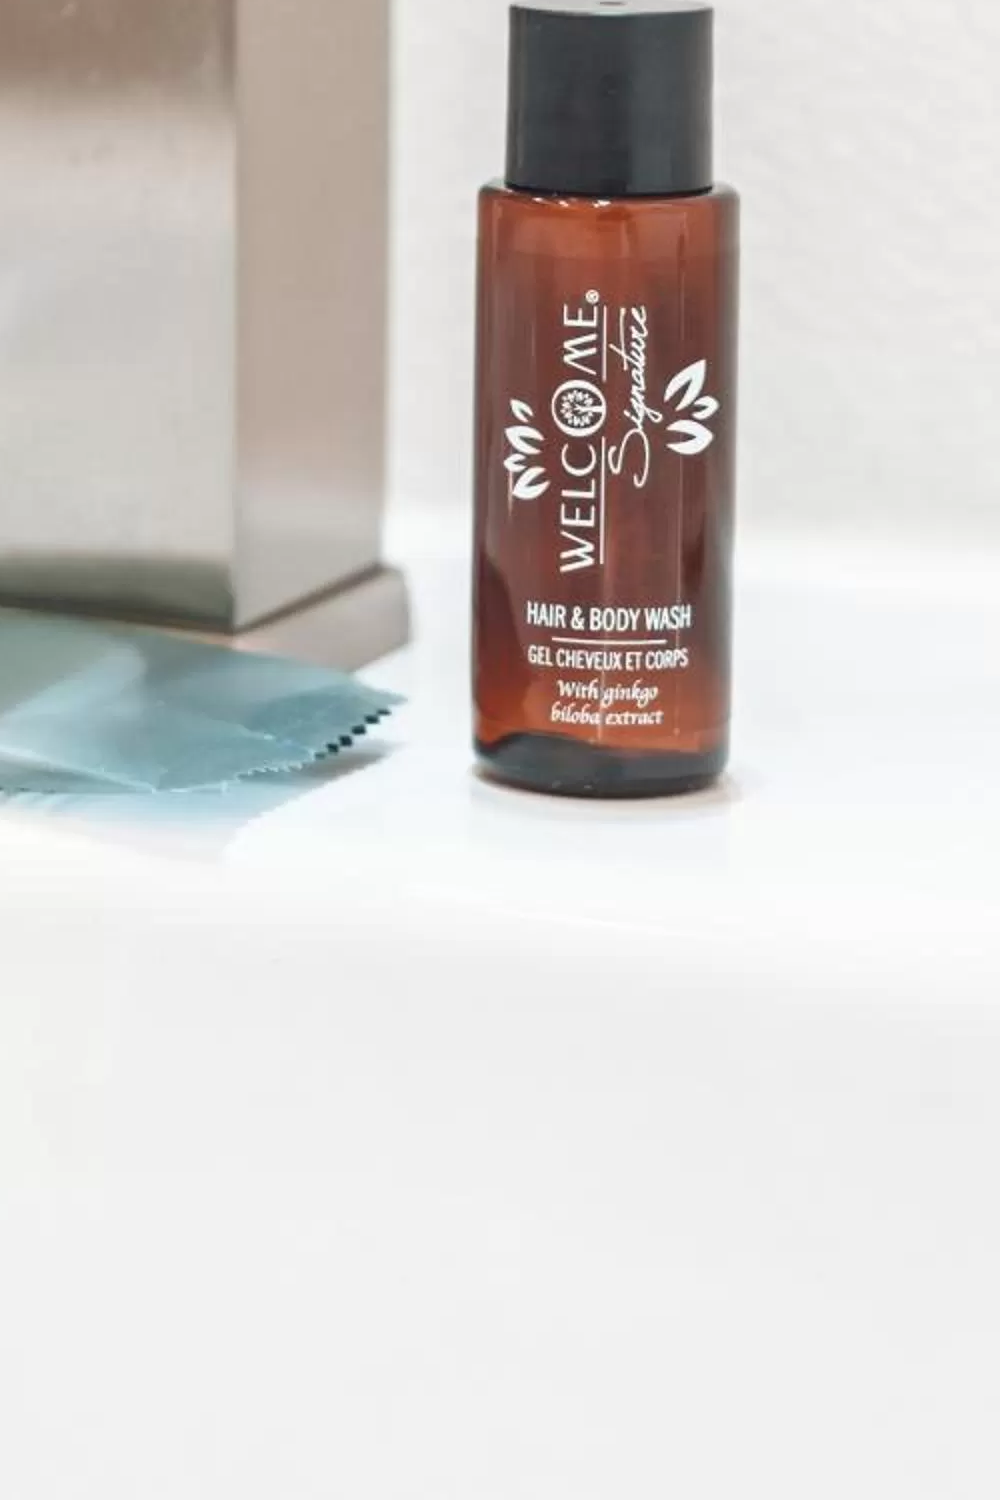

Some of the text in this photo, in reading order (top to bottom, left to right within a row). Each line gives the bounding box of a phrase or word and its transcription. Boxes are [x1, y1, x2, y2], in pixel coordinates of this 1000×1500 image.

[608, 305, 663, 488] Signature
[526, 601, 692, 631] HAIR & BODY WASH
[528, 645, 689, 671] GEL CHEVEUX ET CORPS
[557, 679, 659, 708] With ginkgo
[551, 703, 665, 725] biloba extract
